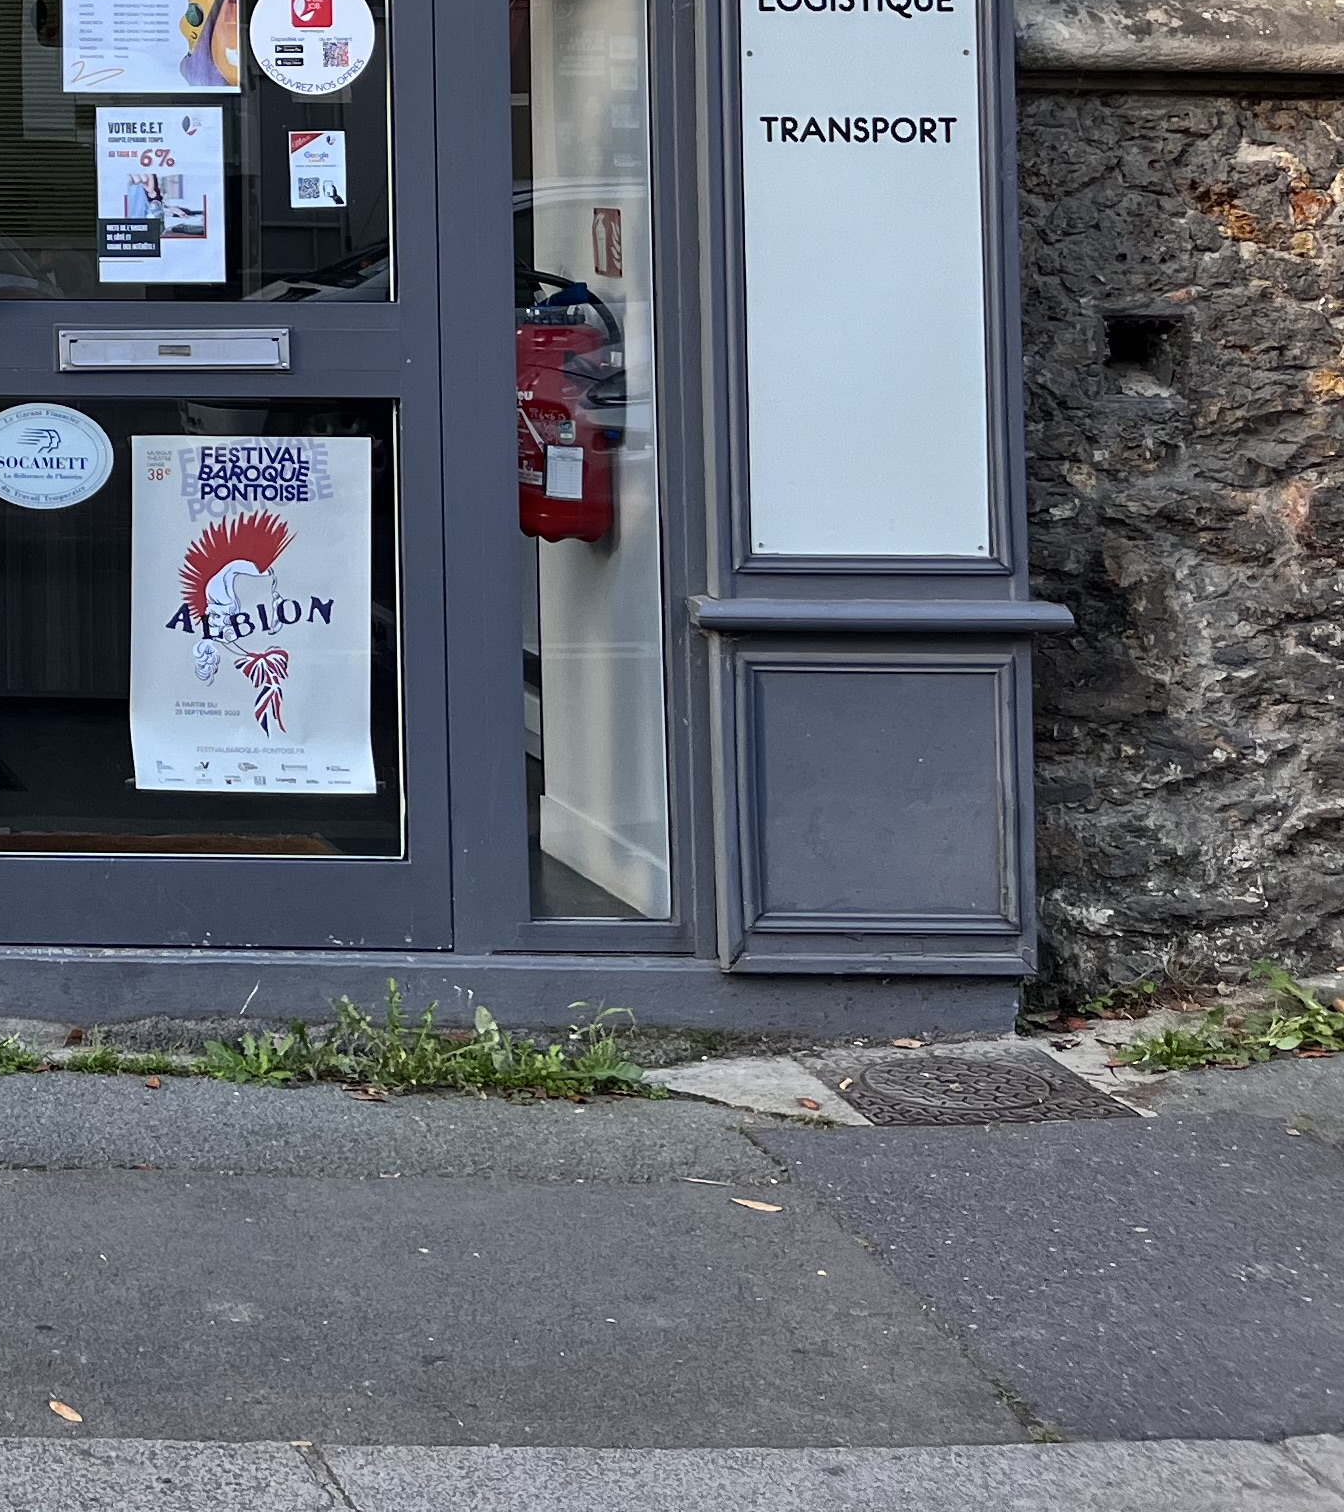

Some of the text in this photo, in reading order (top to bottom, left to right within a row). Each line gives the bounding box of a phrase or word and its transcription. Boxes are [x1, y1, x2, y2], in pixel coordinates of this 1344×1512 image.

[316, 80, 337, 92] NOS
[336, 59, 365, 85] OFFRES
[108, 121, 137, 134] VOTRE
[759, 116, 958, 143] TRANSPORT
[140, 148, 175, 167] 6%
[201, 446, 310, 465] FESTIVAL
[197, 464, 310, 484] BAROQUE
[200, 484, 309, 502] PONTOISE
[165, 595, 335, 640] ALBION
